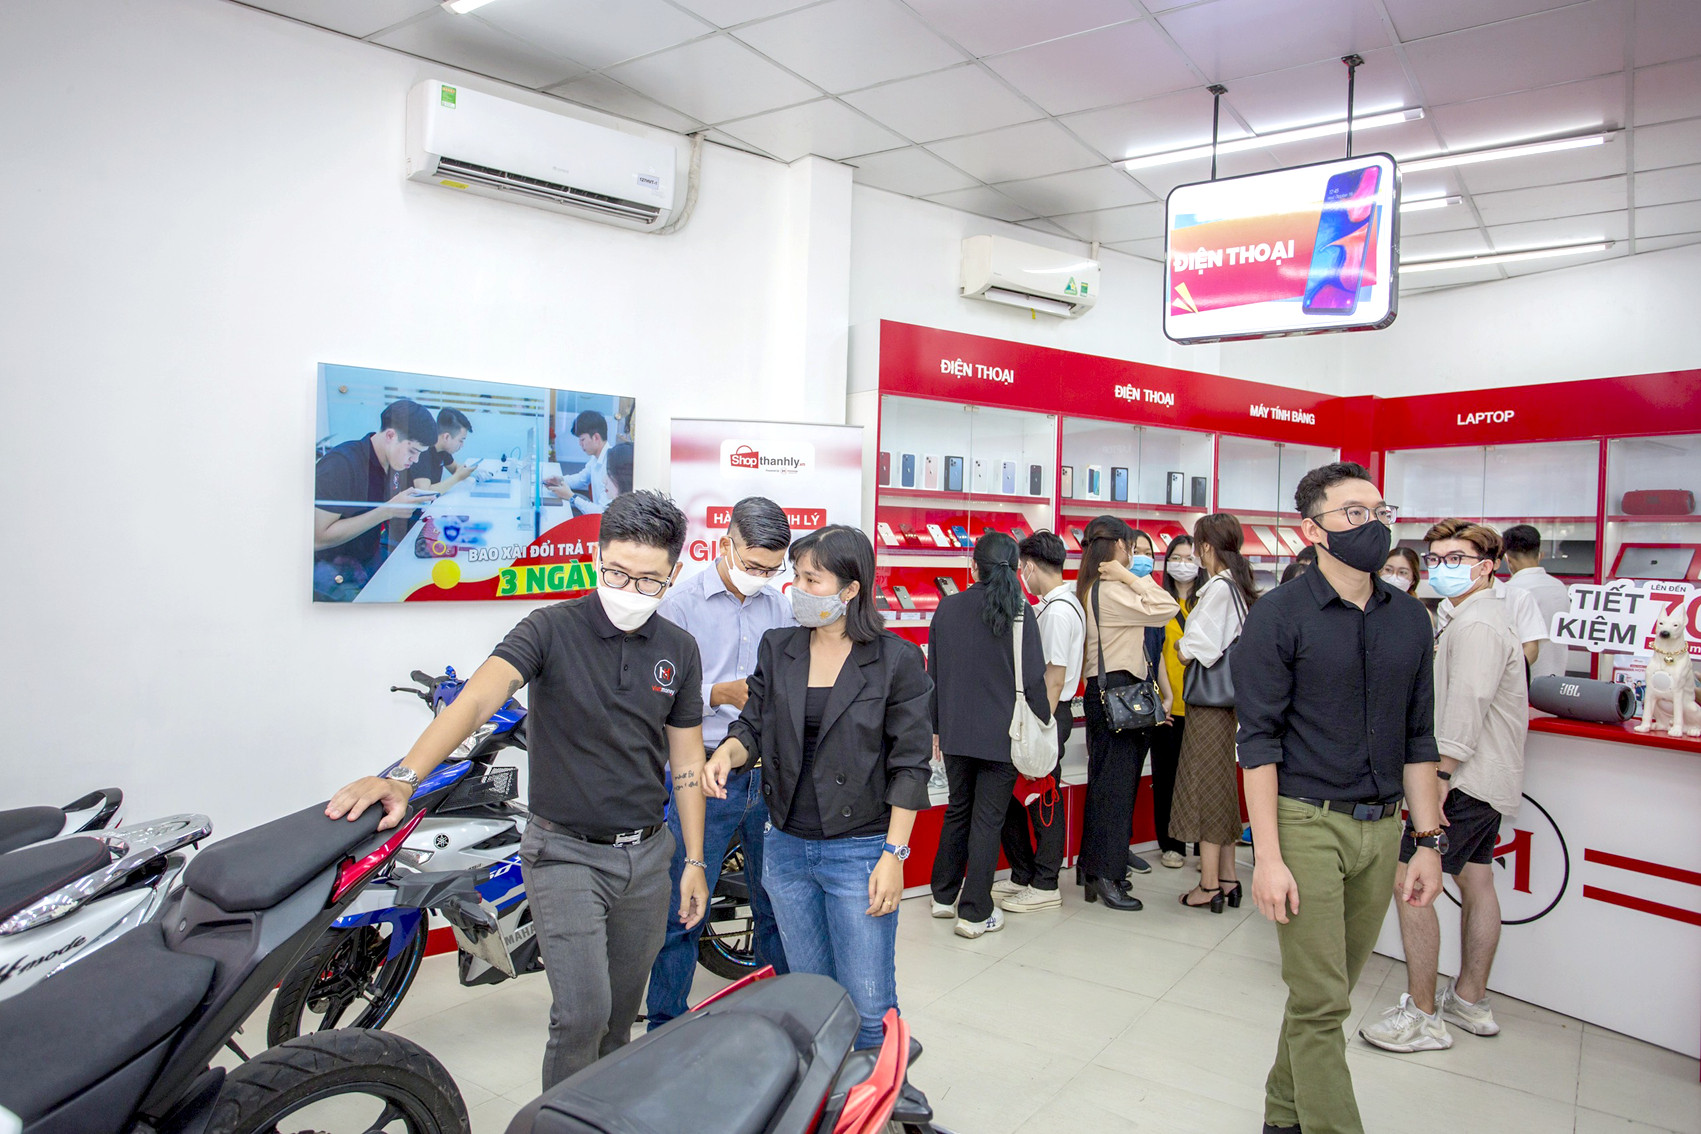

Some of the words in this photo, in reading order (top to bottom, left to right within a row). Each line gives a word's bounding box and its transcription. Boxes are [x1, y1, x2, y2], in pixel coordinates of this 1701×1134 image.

[1173, 246, 1223, 275] ĐIỆN
[1226, 239, 1294, 266] THOẠI
[940, 358, 973, 379] ĐIỆN
[975, 364, 1014, 385] THOẠI
[1114, 383, 1140, 402] ĐIỆN
[1143, 389, 1175, 408] THOẠI
[1250, 403, 1269, 418] MÁY
[1270, 406, 1291, 421] TÍNH
[1291, 408, 1316, 425] BẢNG
[1457, 410, 1515, 425] LAPTOP
[731, 455, 757, 468] Shop
[803, 512, 820, 526] LÝ
[468, 547, 499, 562] BAO
[501, 543, 527, 560] XÀI
[530, 540, 554, 558] ĐỔI
[557, 538, 584, 556] TRẢ
[500, 568, 518, 596] 3
[526, 559, 598, 593] NGÀY
[1651, 584, 1667, 592] LÊN
[1669, 585, 1687, 593] ĐẾN
[1575, 585, 1645, 615] TIẾT
[1556, 615, 1637, 646] KIỆM
[1559, 683, 1581, 697] JBL
[504, 924, 536, 946] MAHA
